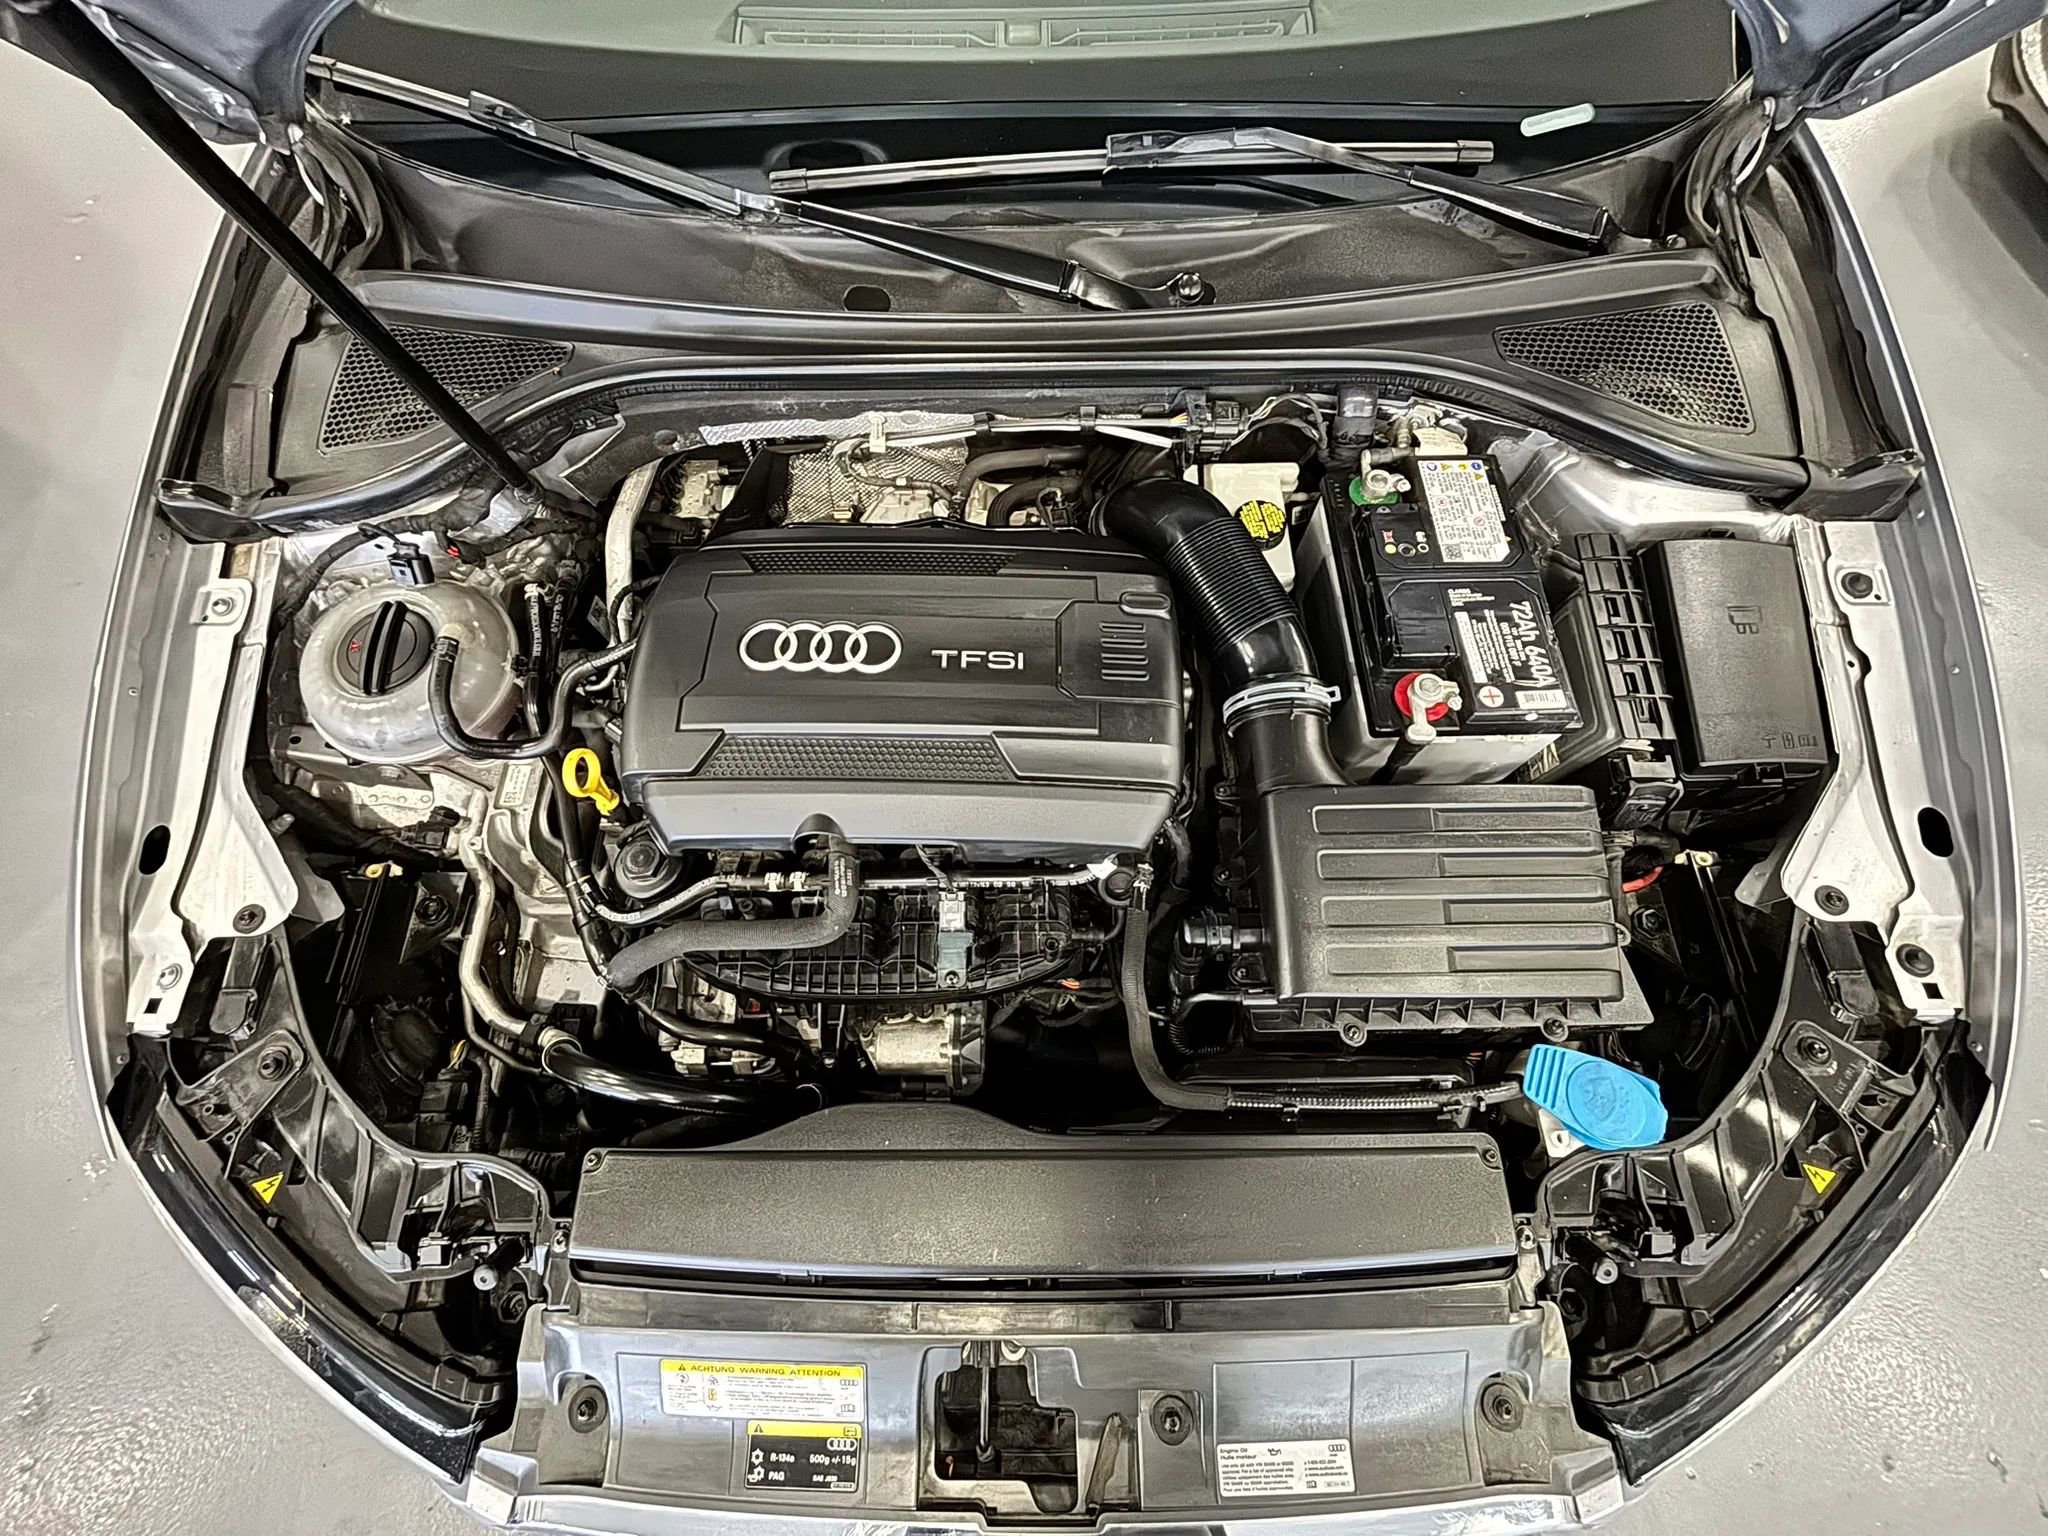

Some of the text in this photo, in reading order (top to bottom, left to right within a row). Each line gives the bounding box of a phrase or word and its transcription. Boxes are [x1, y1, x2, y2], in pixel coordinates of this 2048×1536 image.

[1509, 601, 1540, 641] 72Ah
[931, 650, 1025, 670] TFSI
[1524, 646, 1557, 687] 640A
[690, 1364, 841, 1377] ACHTUNG WARNING ATTENTION
[769, 1452, 795, 1463] R-134a
[768, 1471, 785, 1481] PAG
